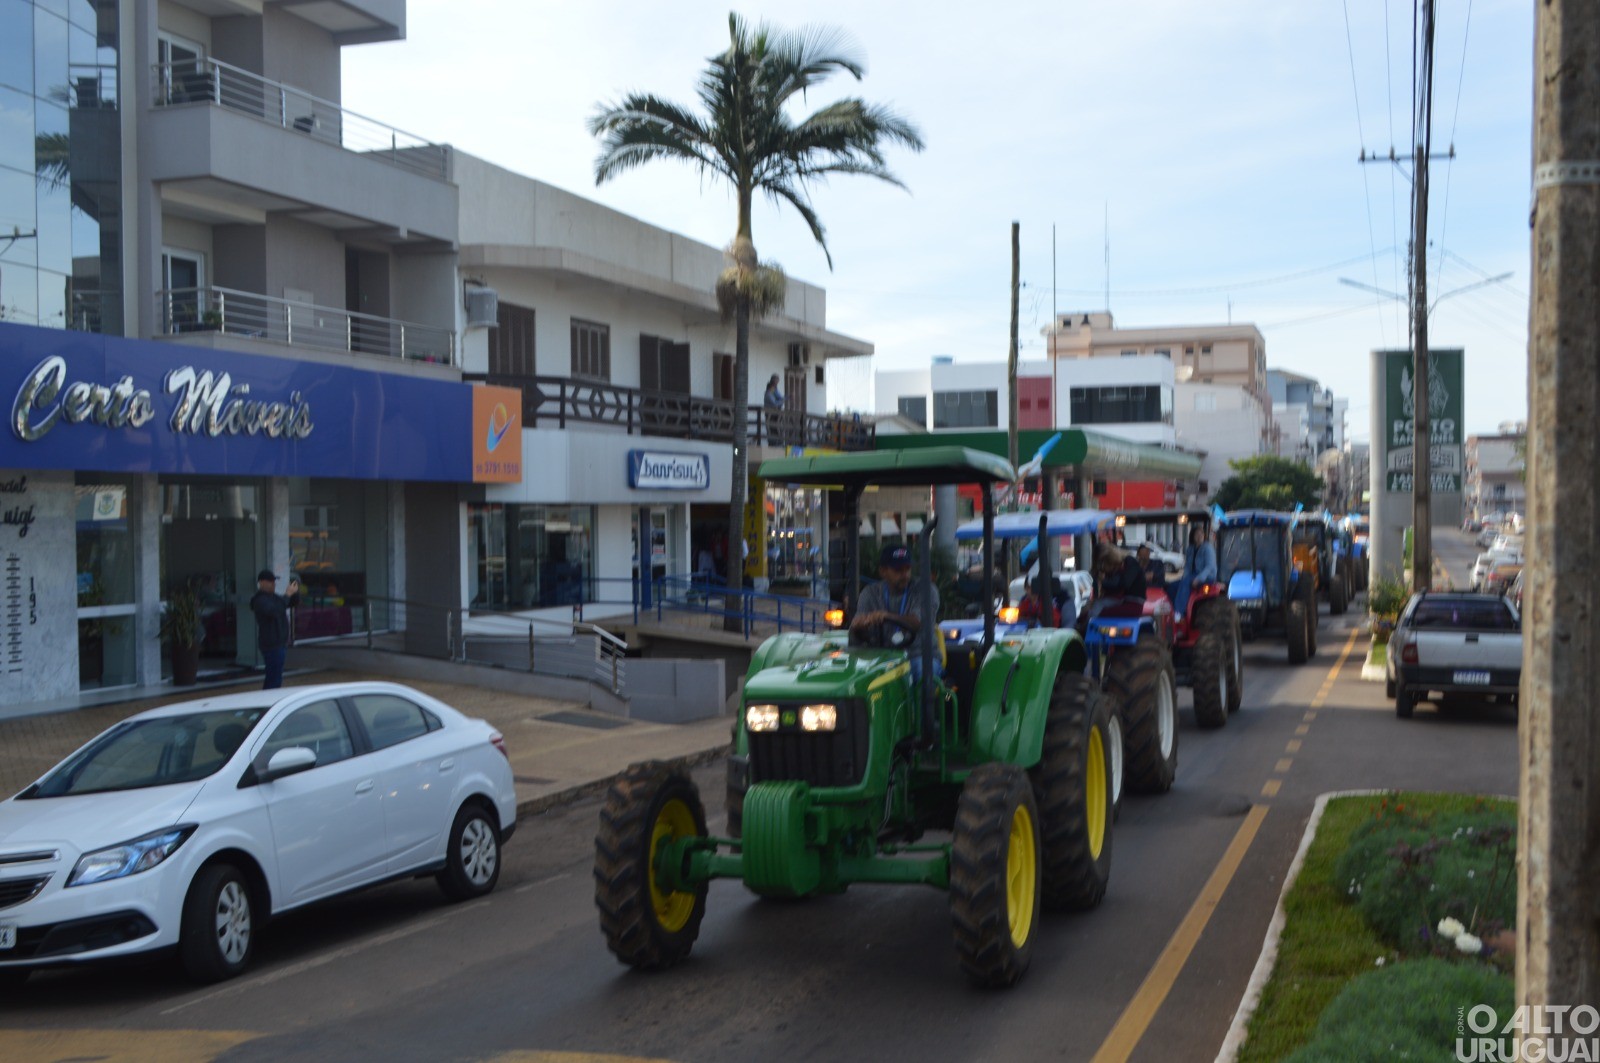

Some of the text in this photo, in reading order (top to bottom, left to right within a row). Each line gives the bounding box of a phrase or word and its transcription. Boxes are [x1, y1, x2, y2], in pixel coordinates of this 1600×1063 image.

[12, 355, 155, 442] Certo
[1393, 418, 1455, 433] POTO
[639, 456, 698, 480] banrisul
